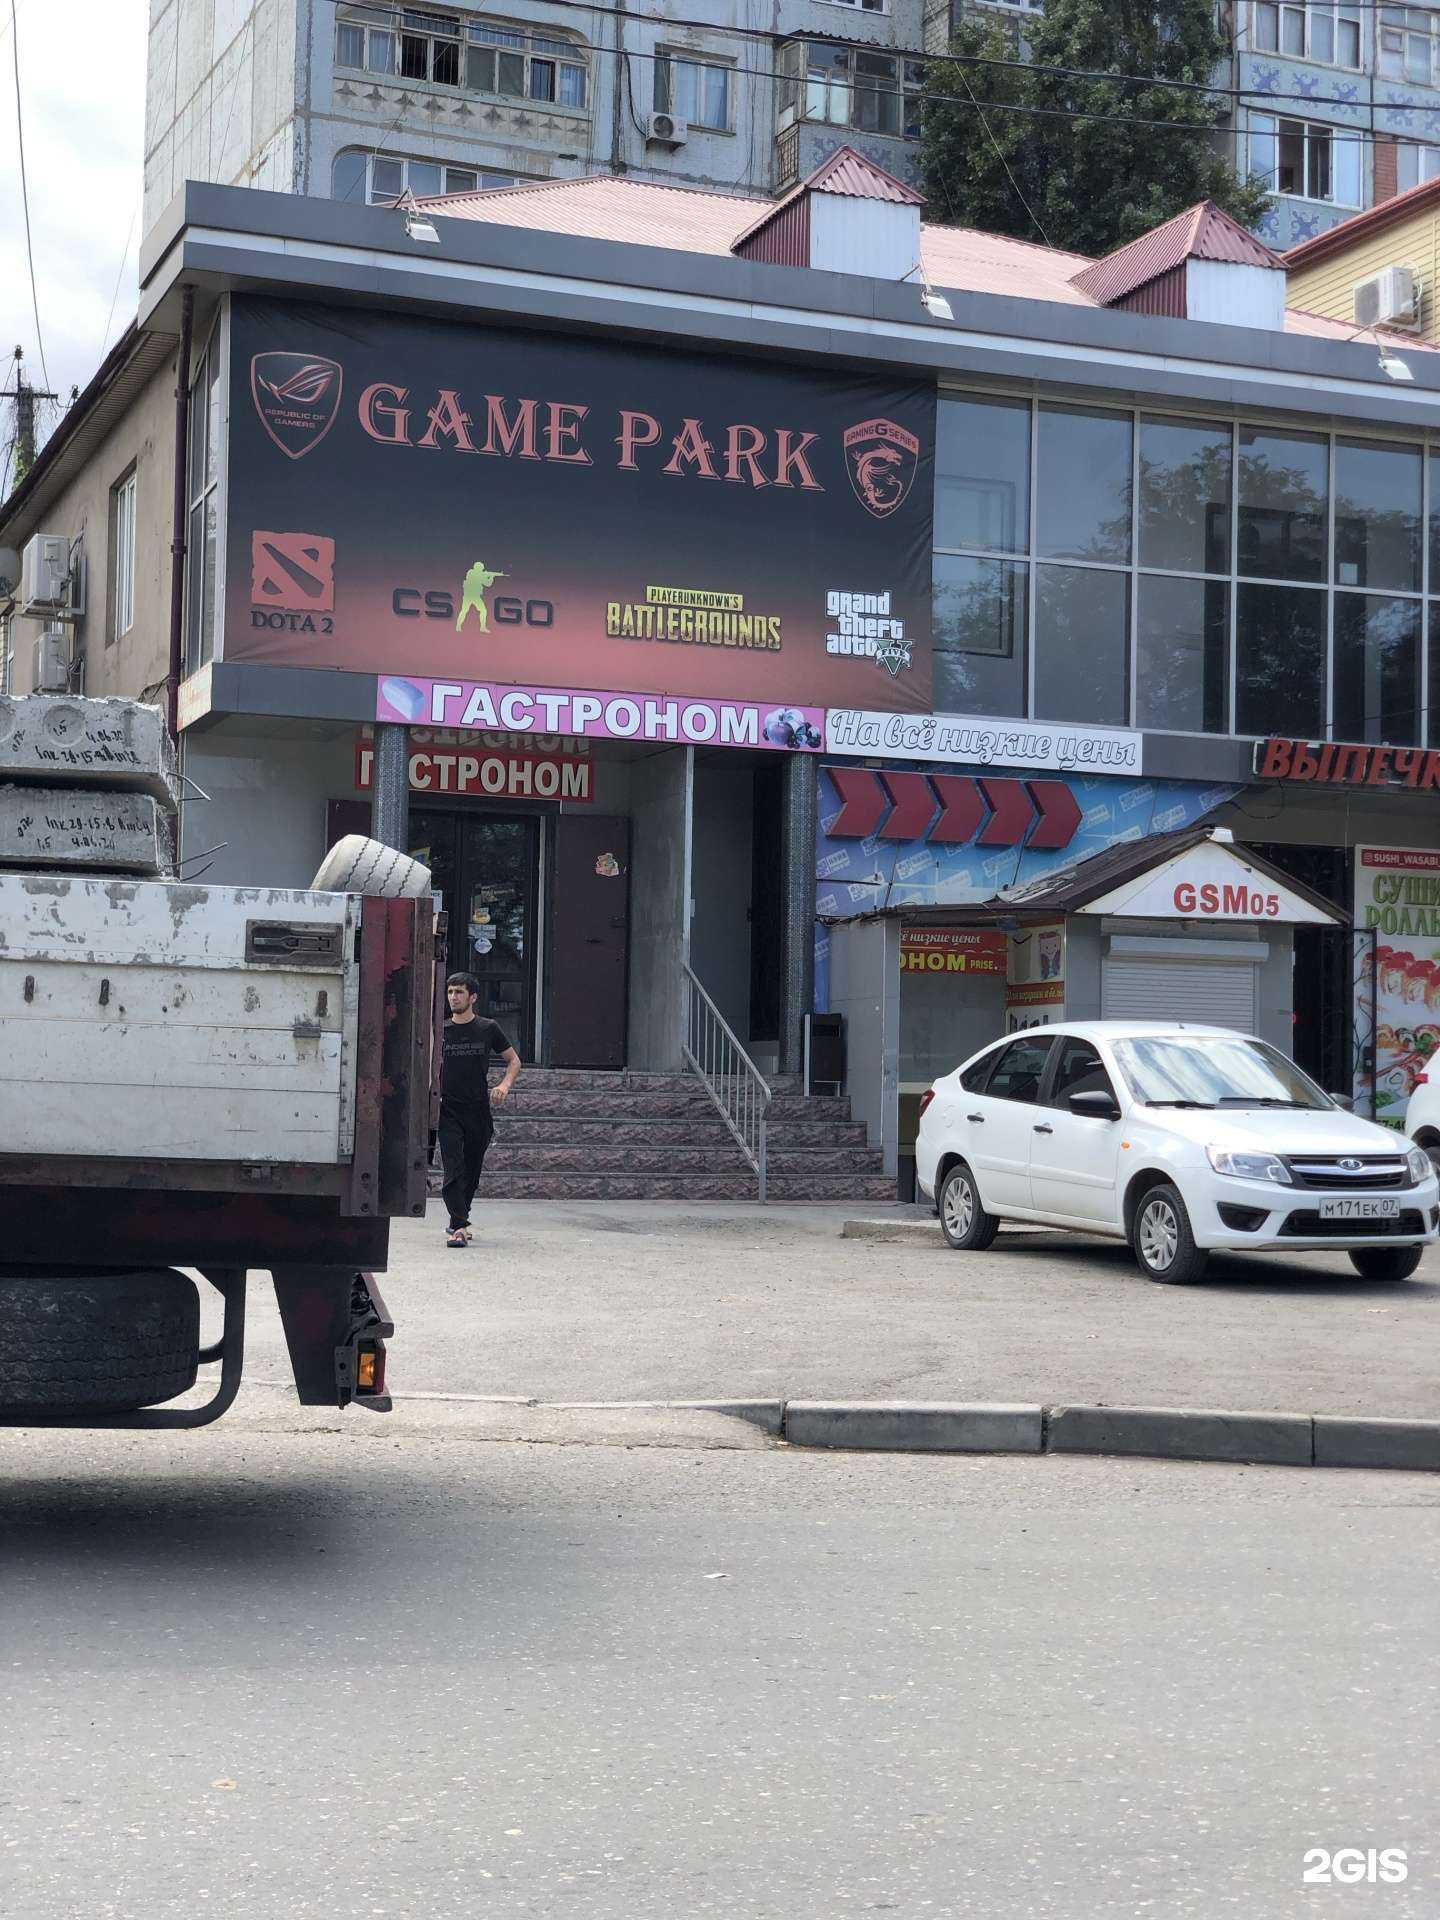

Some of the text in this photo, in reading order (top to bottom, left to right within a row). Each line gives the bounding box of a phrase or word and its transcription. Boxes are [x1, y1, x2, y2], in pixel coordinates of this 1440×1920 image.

[358, 382, 826, 492] GAME PARK
[393, 588, 553, 626] CS GO
[650, 588, 740, 609] PLAYERUNKNOWN'S
[250, 610, 333, 634] DOTA 2
[606, 602, 782, 650] BATTLEGROUNDS
[826, 633, 878, 656] auto
[430, 683, 760, 746] ГАСТРОНОМ
[831, 711, 1137, 770] На всё низкие цены
[360, 750, 589, 798] ГСТРОНОМ
[1173, 883, 1280, 916] GSM05
